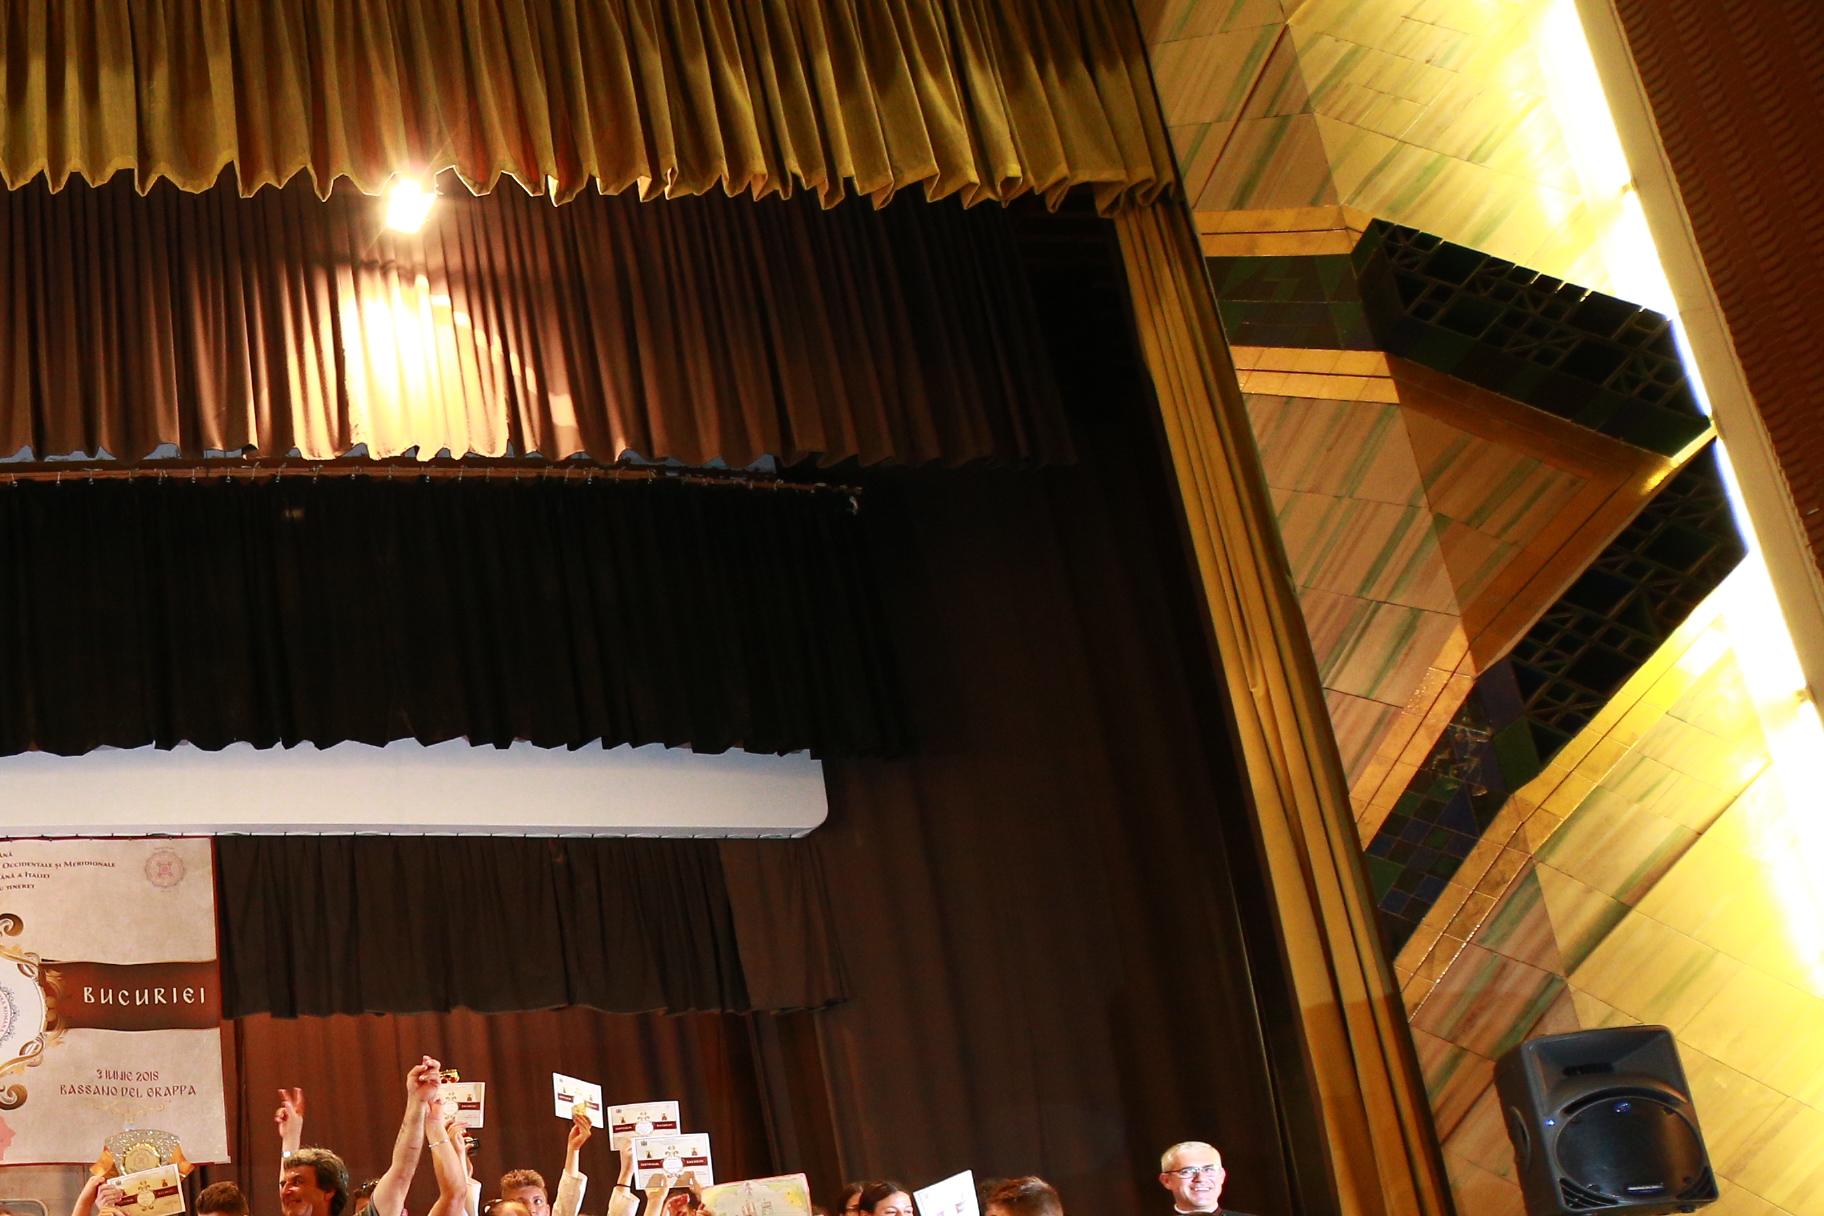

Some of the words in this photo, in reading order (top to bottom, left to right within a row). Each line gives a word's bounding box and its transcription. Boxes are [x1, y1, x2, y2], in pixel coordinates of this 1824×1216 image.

[83, 986, 206, 1006] BUCURIEI
[96, 1068, 103, 1080] 3
[135, 1070, 159, 1082] 2018
[60, 1084, 118, 1097] BASSANO
[121, 1086, 143, 1098] DEL
[147, 1085, 197, 1098] GRAPPA
